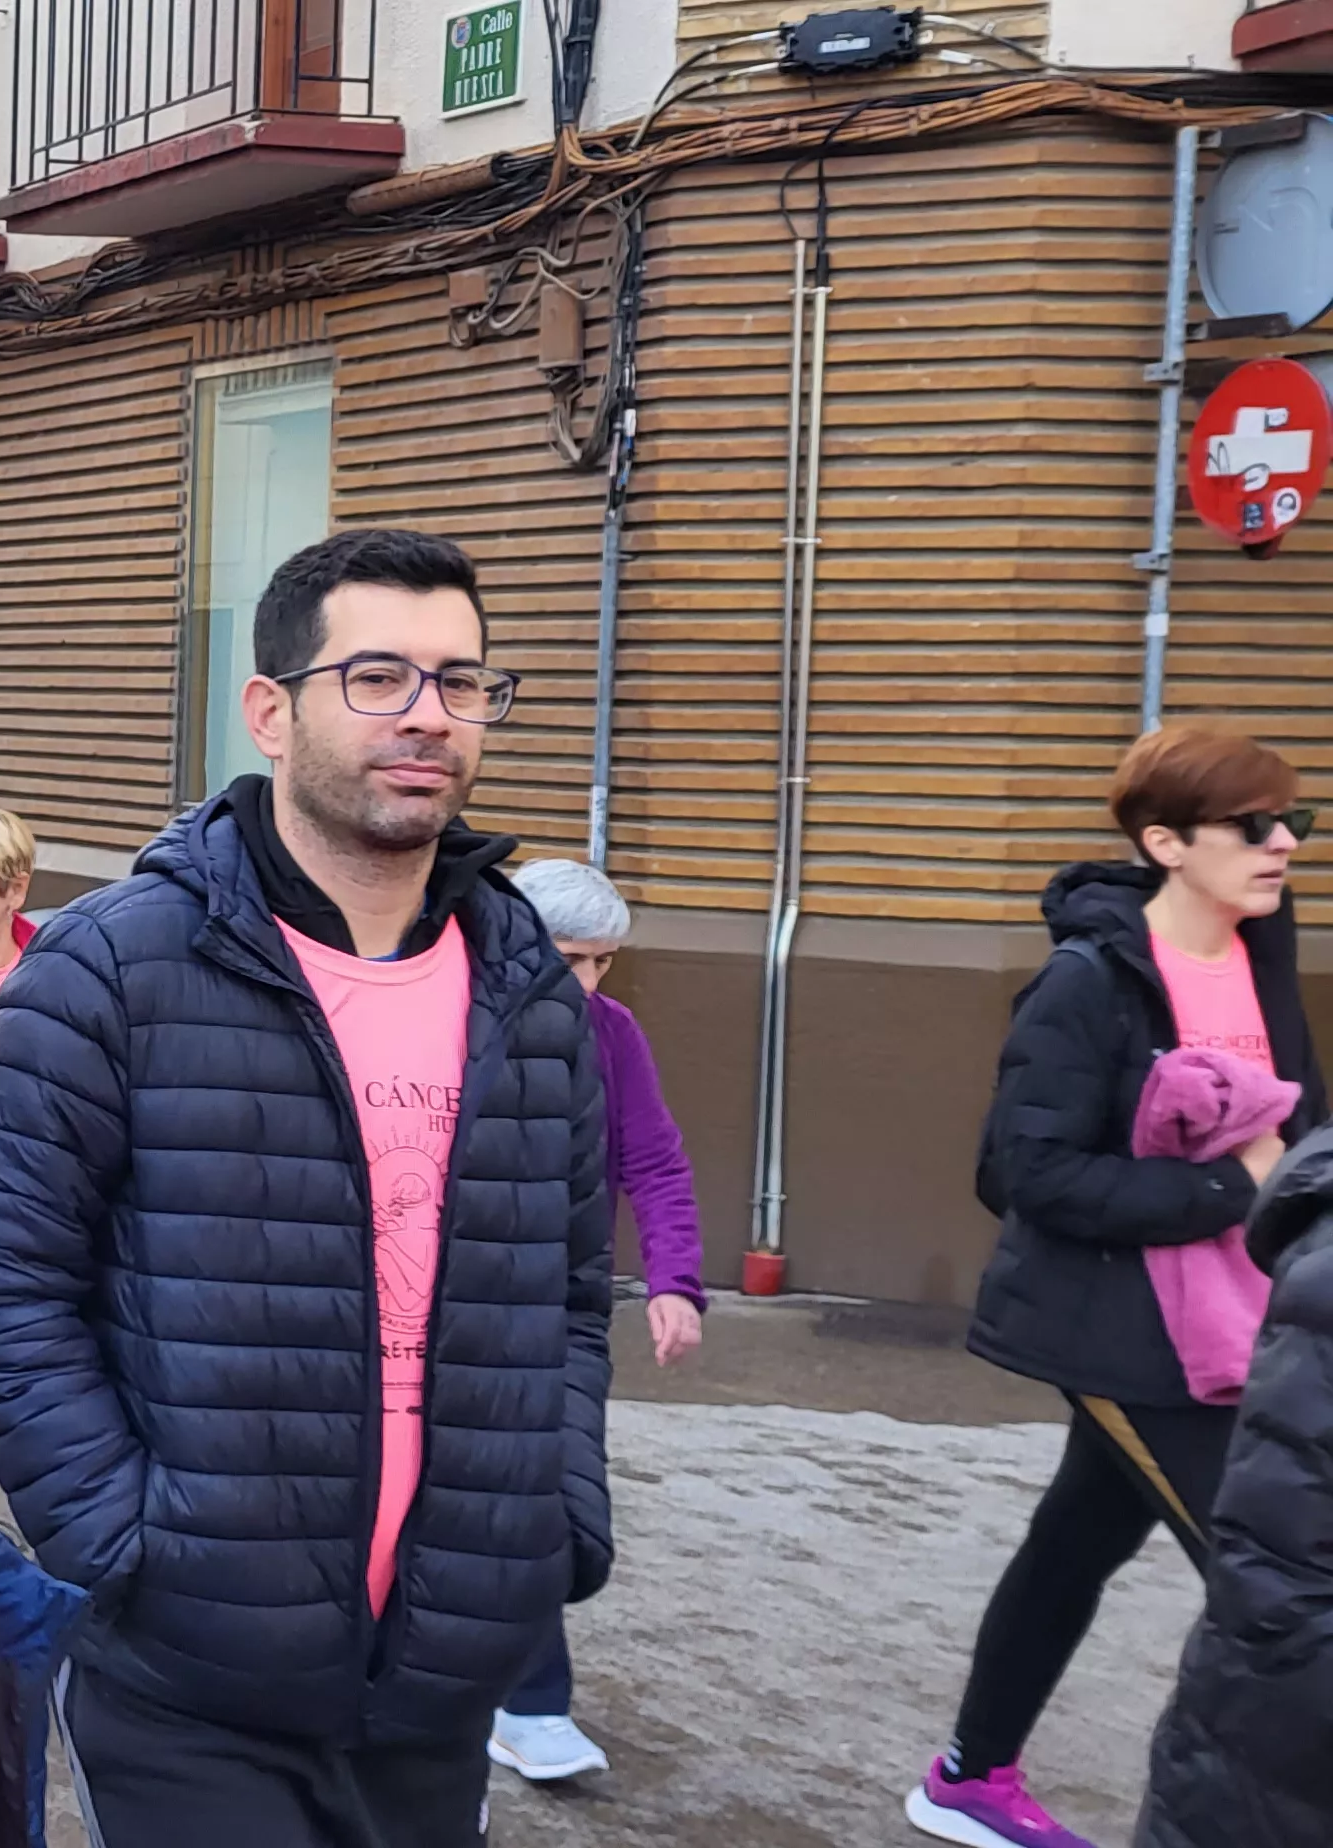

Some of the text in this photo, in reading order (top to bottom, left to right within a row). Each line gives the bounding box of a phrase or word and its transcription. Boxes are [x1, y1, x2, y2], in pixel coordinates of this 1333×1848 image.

[480, 9, 513, 35] Calle
[460, 37, 502, 74] PADRE
[454, 69, 503, 106] HUESCA
